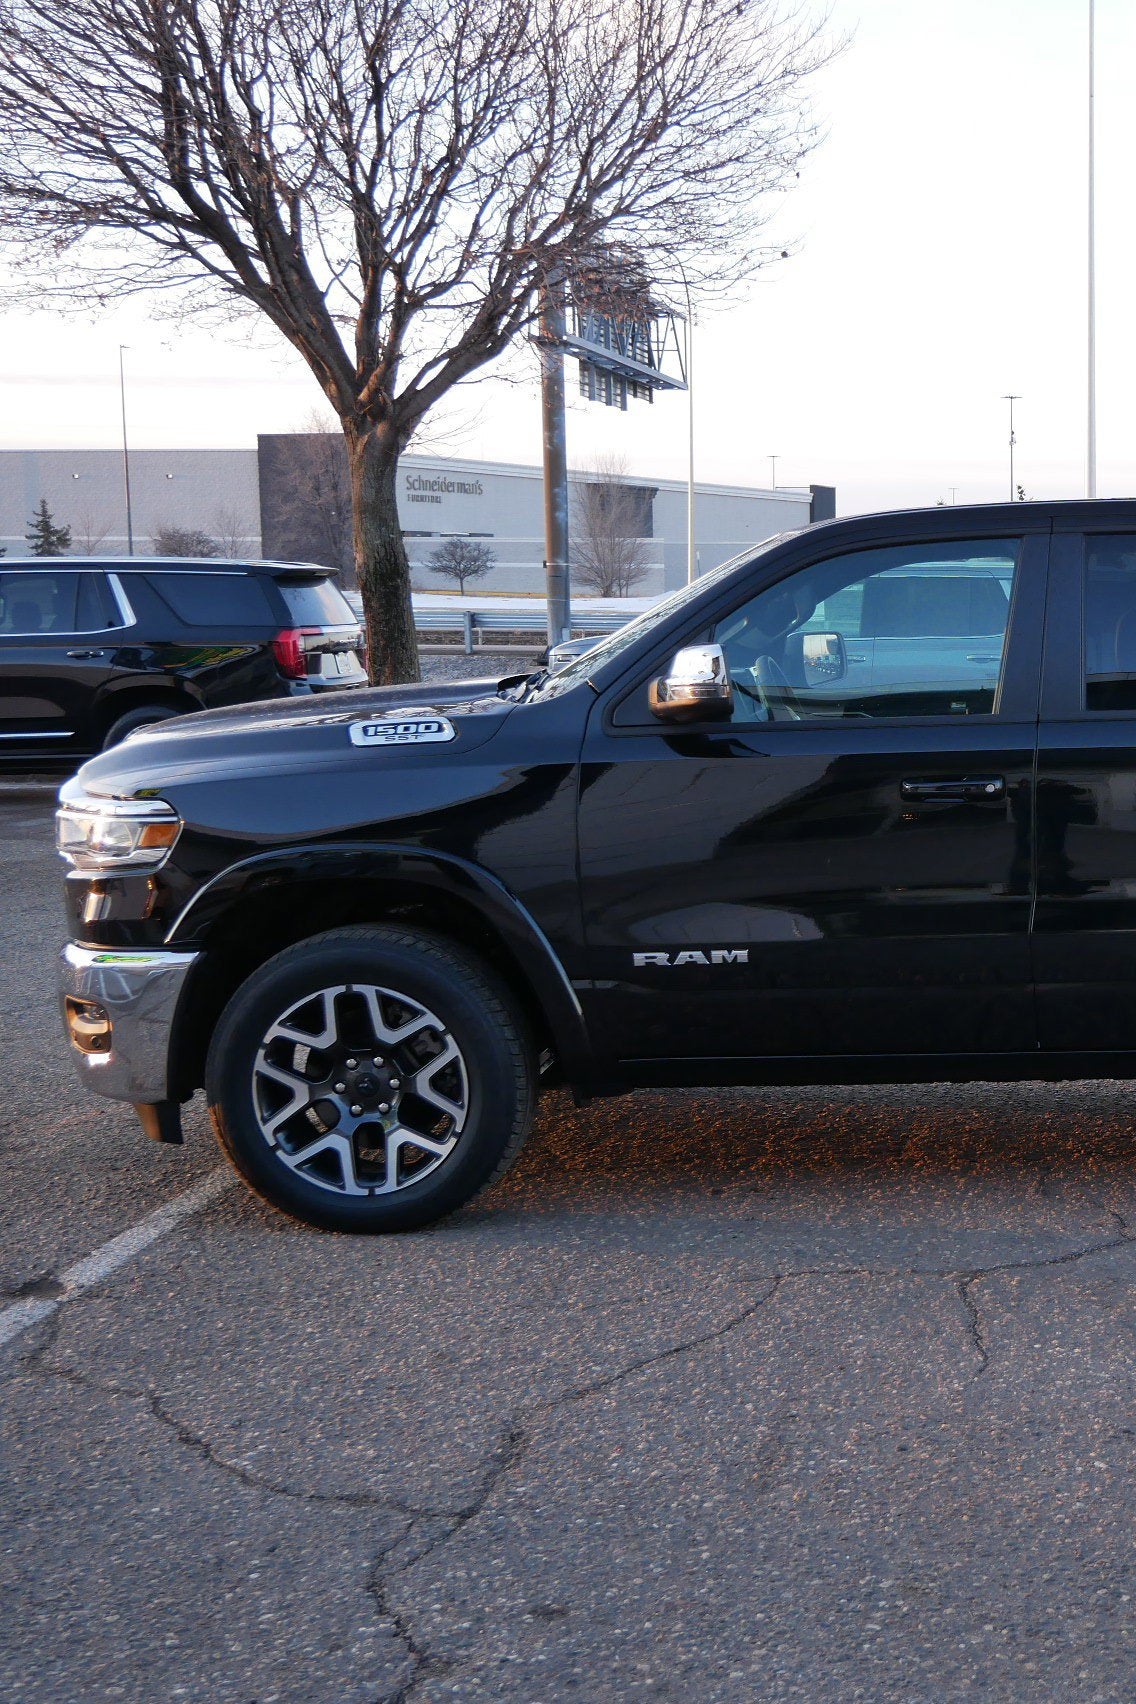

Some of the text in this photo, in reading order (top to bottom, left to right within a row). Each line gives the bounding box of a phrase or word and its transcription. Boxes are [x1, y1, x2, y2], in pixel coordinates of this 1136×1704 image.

[406, 474, 484, 495] Schneiderman's
[365, 722, 439, 736] 1500
[385, 734, 423, 742] SST
[632, 949, 749, 967] RAM
